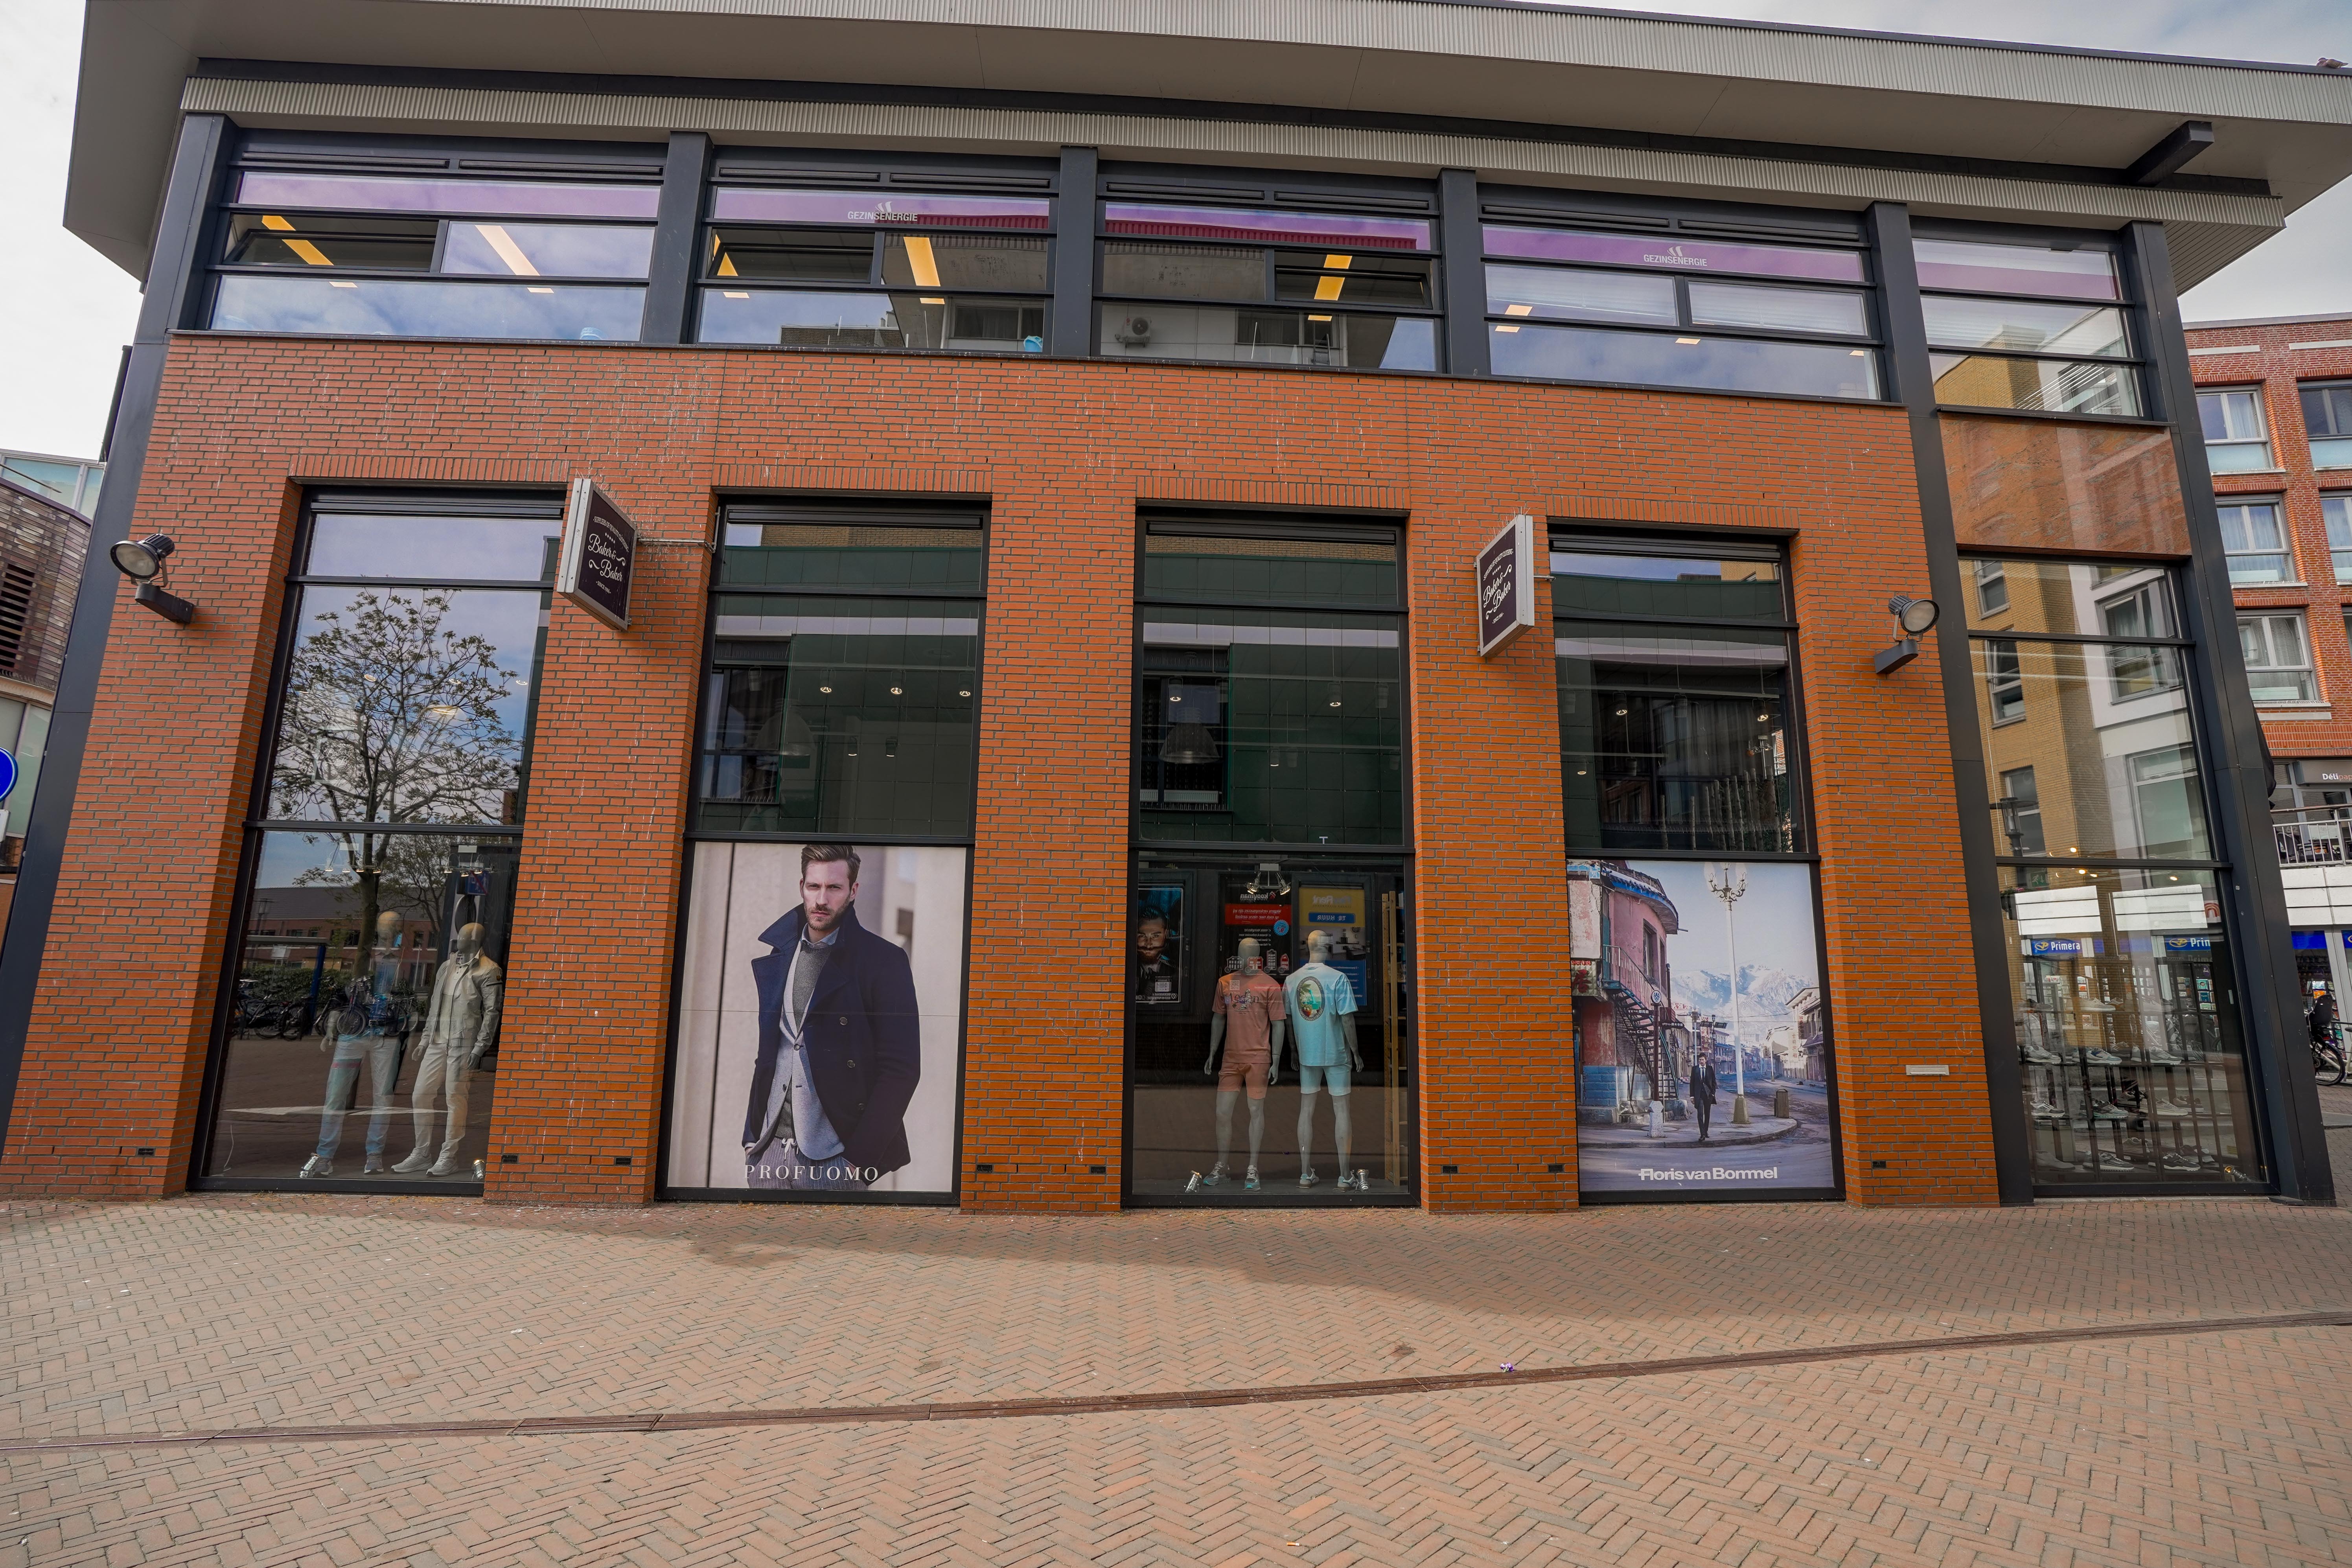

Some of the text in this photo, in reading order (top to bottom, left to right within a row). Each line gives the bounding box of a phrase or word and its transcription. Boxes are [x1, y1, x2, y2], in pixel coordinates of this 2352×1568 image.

[847, 211, 918, 221] GEZINSENERGIE
[1643, 254, 1708, 267] GEZINSENERGIE
[594, 516, 606, 526] SUPPLIERS
[609, 524, 619, 537] QUALITY
[588, 534, 611, 558] Baker
[600, 559, 623, 582] Baker
[1483, 577, 1500, 608] Baker
[1493, 581, 1511, 612] Baker
[2051, 941, 2080, 950] Primera
[744, 1165, 879, 1182] PROFUOMO
[1638, 1167, 1778, 1181] Floris van Bommel
